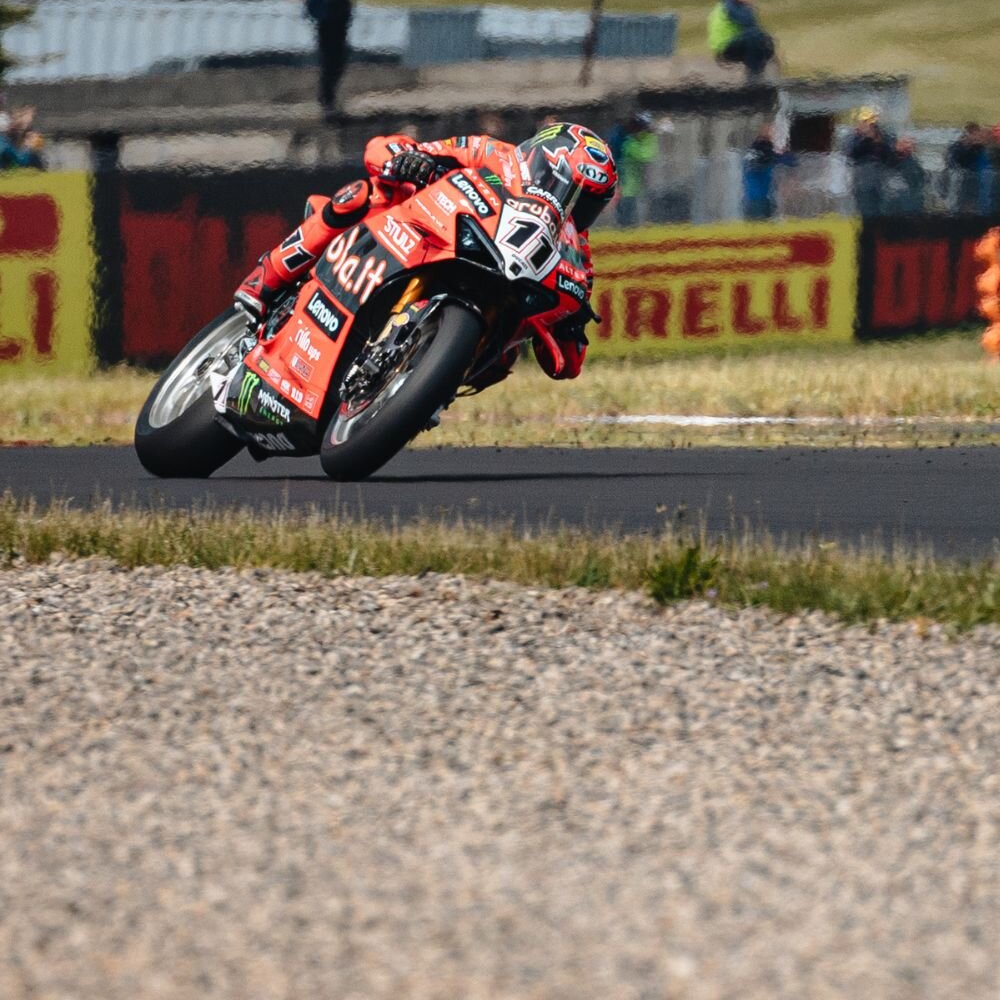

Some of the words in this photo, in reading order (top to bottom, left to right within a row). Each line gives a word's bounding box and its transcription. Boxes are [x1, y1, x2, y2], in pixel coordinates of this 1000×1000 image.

[451, 173, 489, 215] Lenovo
[384, 215, 416, 254] STULZ
[502, 217, 554, 273] 11
[308, 292, 340, 332] Lenovo
[597, 275, 832, 339] IRELLI
